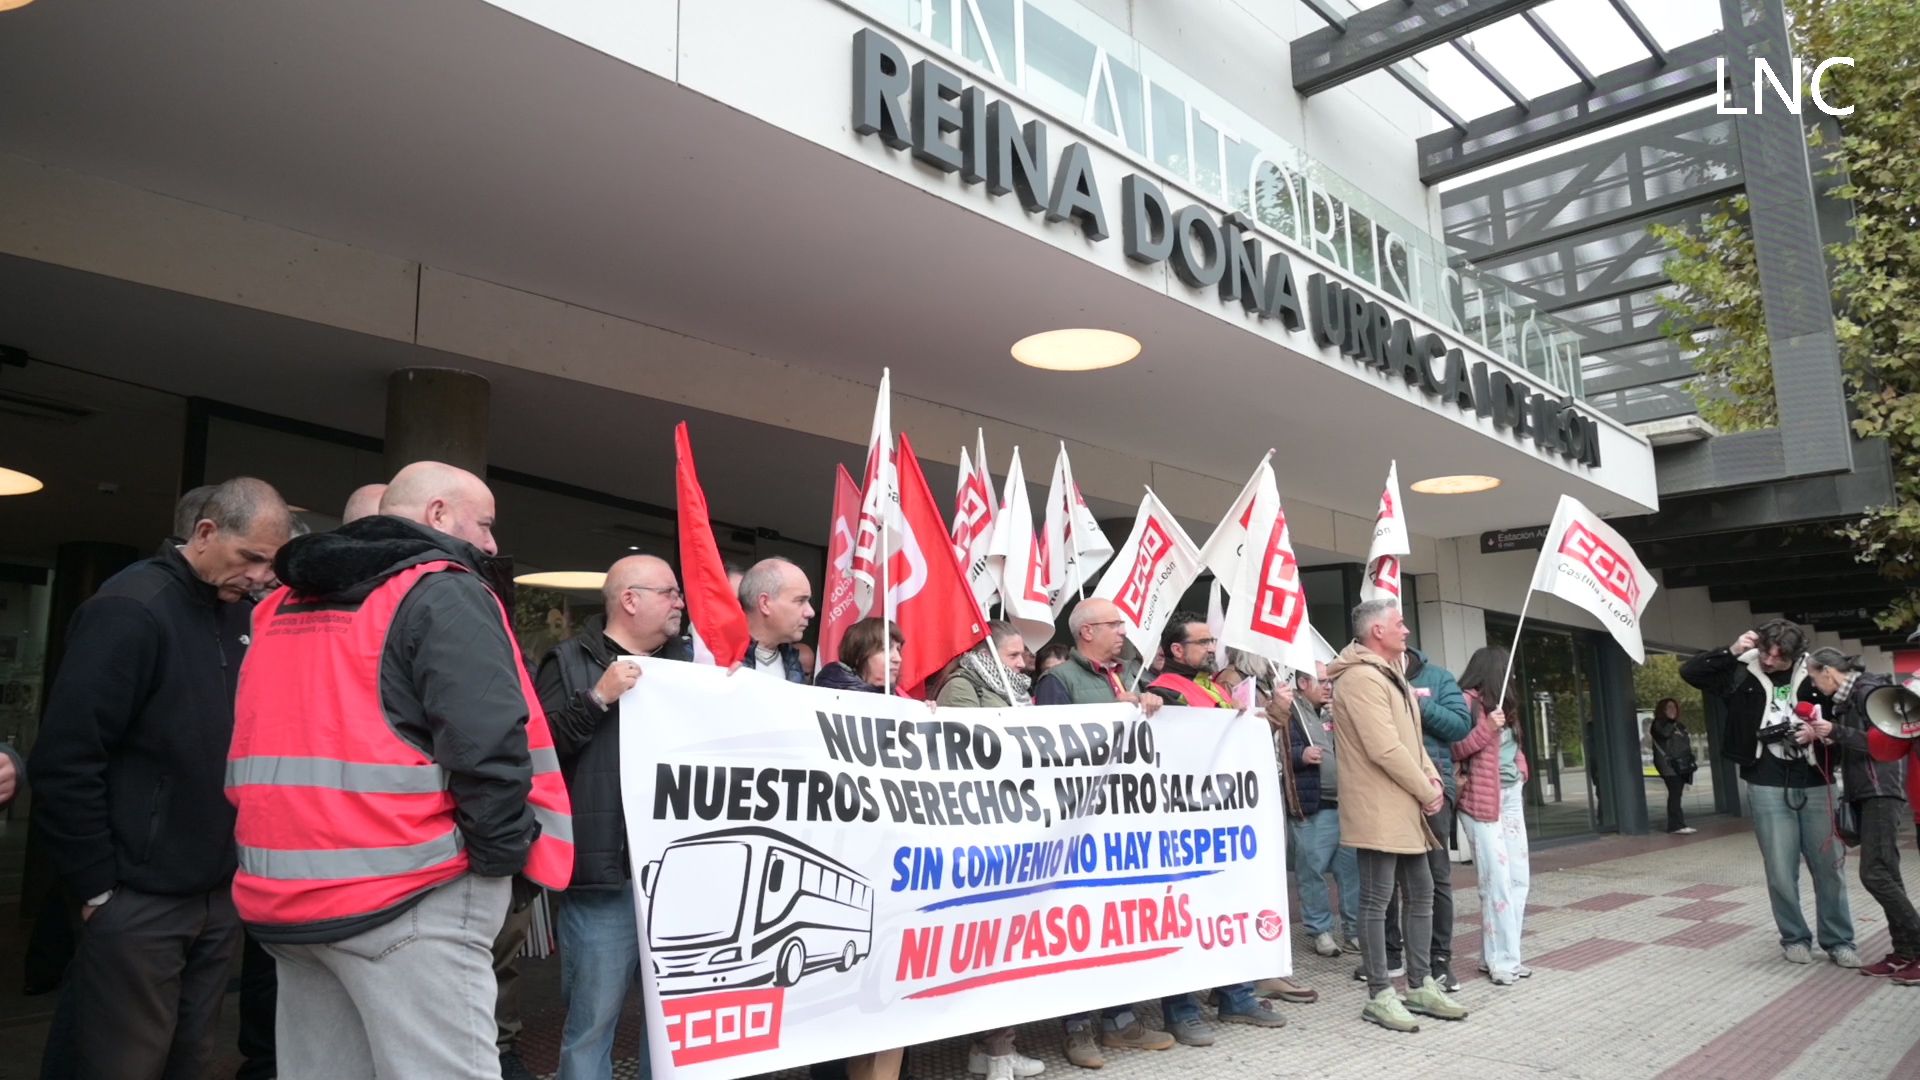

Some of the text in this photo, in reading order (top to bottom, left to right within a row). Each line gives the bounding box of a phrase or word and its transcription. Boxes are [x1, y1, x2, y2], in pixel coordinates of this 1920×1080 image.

[853, 27, 1109, 242] REINA
[1121, 173, 1306, 331] DOÑA
[1307, 272, 1476, 411] URRACA
[1490, 370, 1534, 439] DE
[1558, 562, 1601, 595] Castilla
[1608, 601, 1635, 630] León
[816, 710, 1160, 771] NUESTRO TRABAJO,
[653, 763, 1260, 828] NUESTROS DERECHOS, NUESTRO SALARIO
[890, 824, 1258, 893] SIN CONVENIO NO HAY RESPETO
[895, 885, 1193, 982] NI UN PASO ATRÁS
[1195, 912, 1250, 951] UGT
